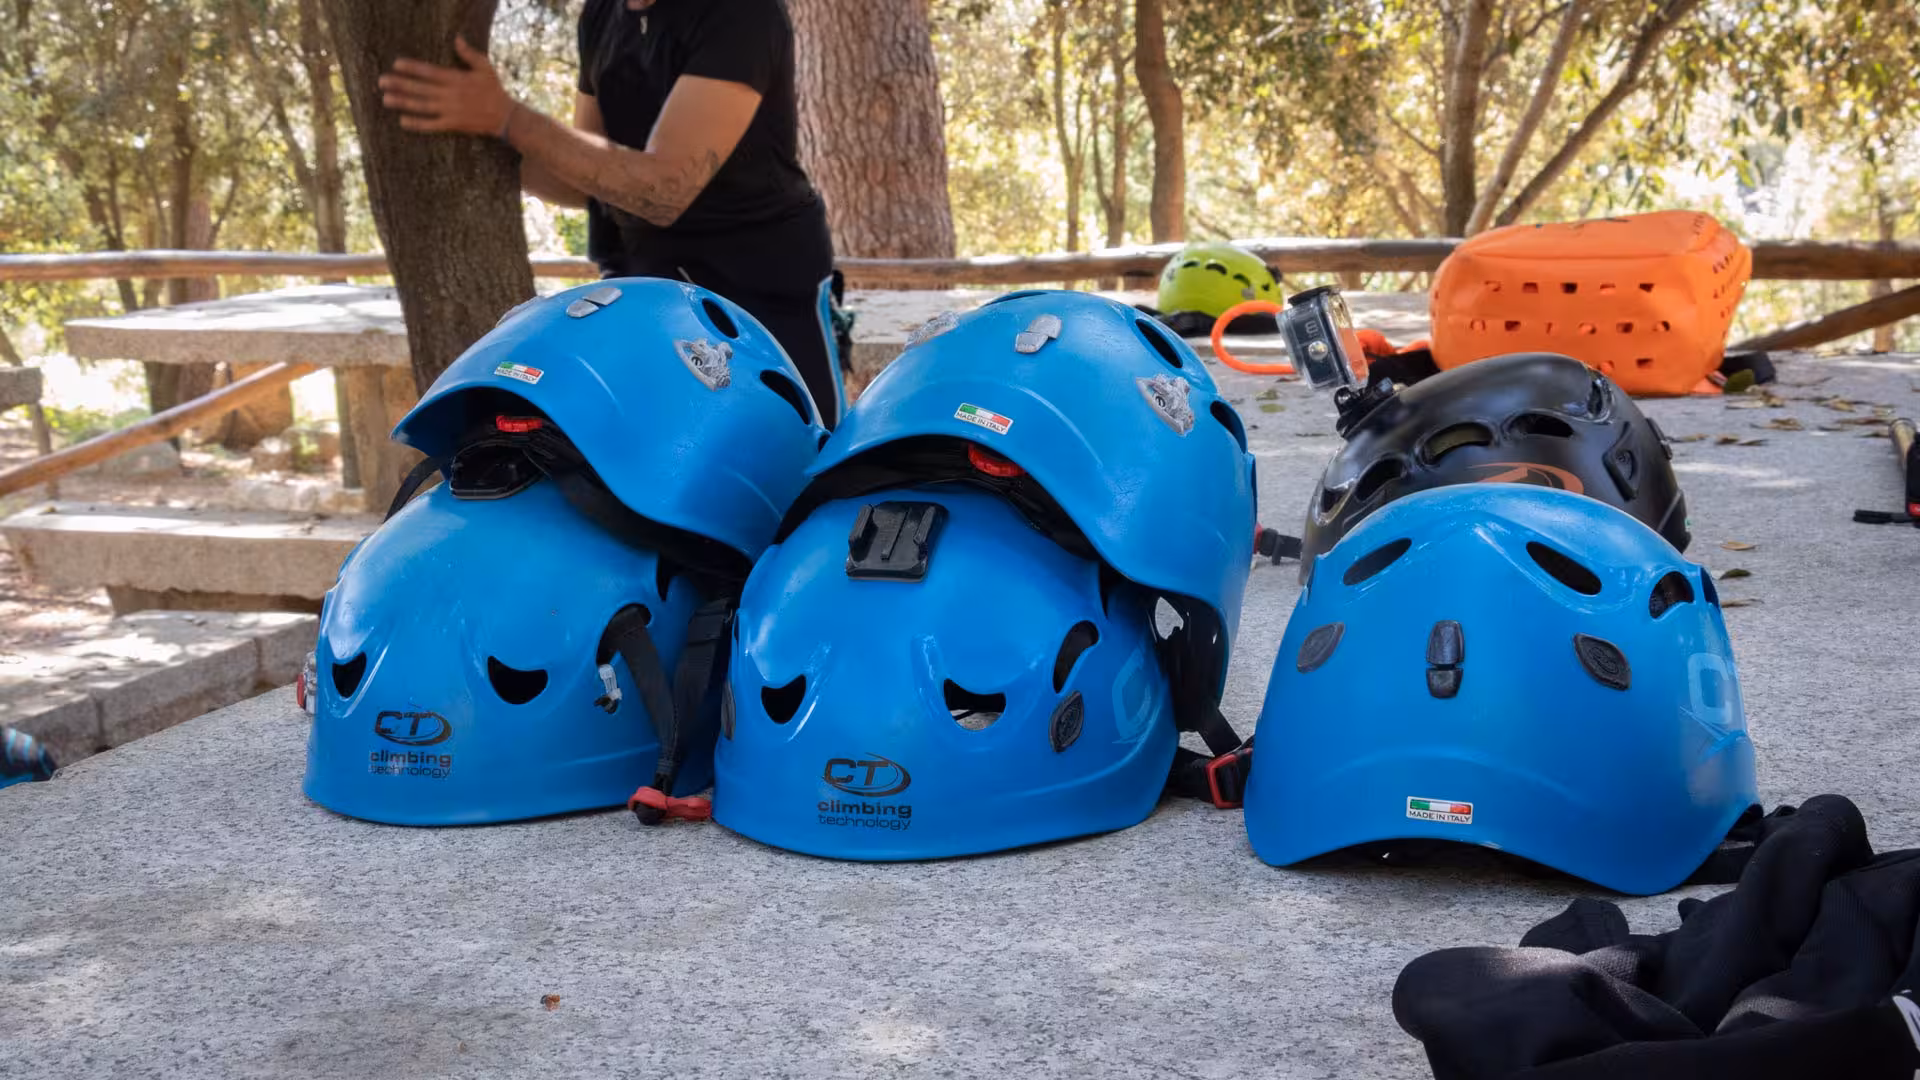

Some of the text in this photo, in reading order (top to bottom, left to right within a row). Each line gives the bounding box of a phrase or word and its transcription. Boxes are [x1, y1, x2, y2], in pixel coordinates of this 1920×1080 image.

[957, 412, 977, 422] MADE
[986, 422, 1006, 432] ITALY
[370, 750, 451, 768] climbing
[369, 764, 451, 778] technology
[817, 800, 912, 819] climbing
[1409, 811, 1434, 819] MADE
[818, 814, 911, 831] technology
